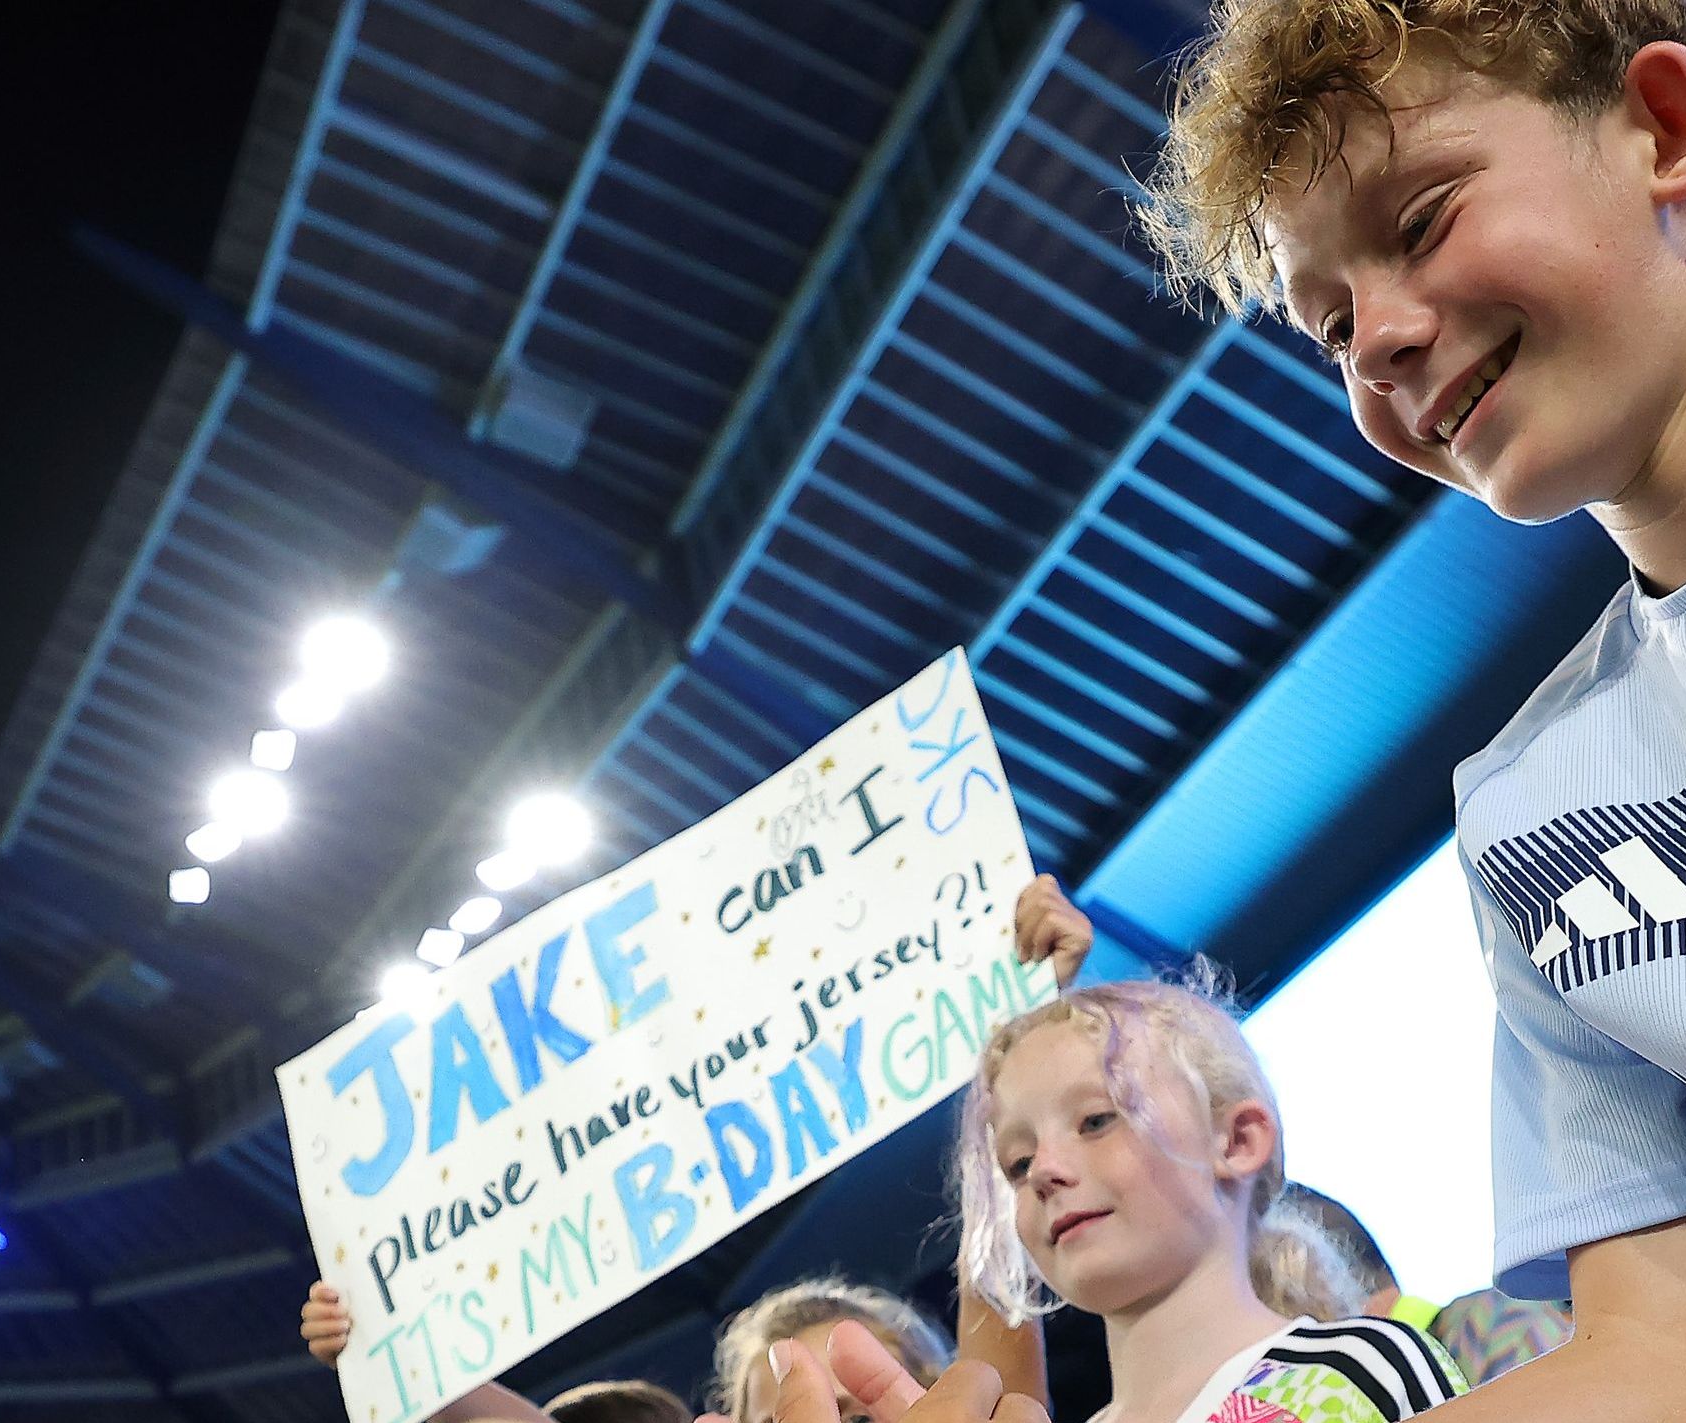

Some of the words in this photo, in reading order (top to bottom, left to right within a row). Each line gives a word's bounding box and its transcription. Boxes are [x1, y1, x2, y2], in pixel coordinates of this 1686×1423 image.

[327, 880, 674, 1199] JAKE
[716, 842, 825, 935] can
[838, 764, 905, 856] I
[367, 1161, 541, 1315] please
[548, 1086, 662, 1175] have
[668, 1016, 773, 1109] your
[521, 1191, 602, 1337] MY
[881, 945, 1059, 1102] GAME
